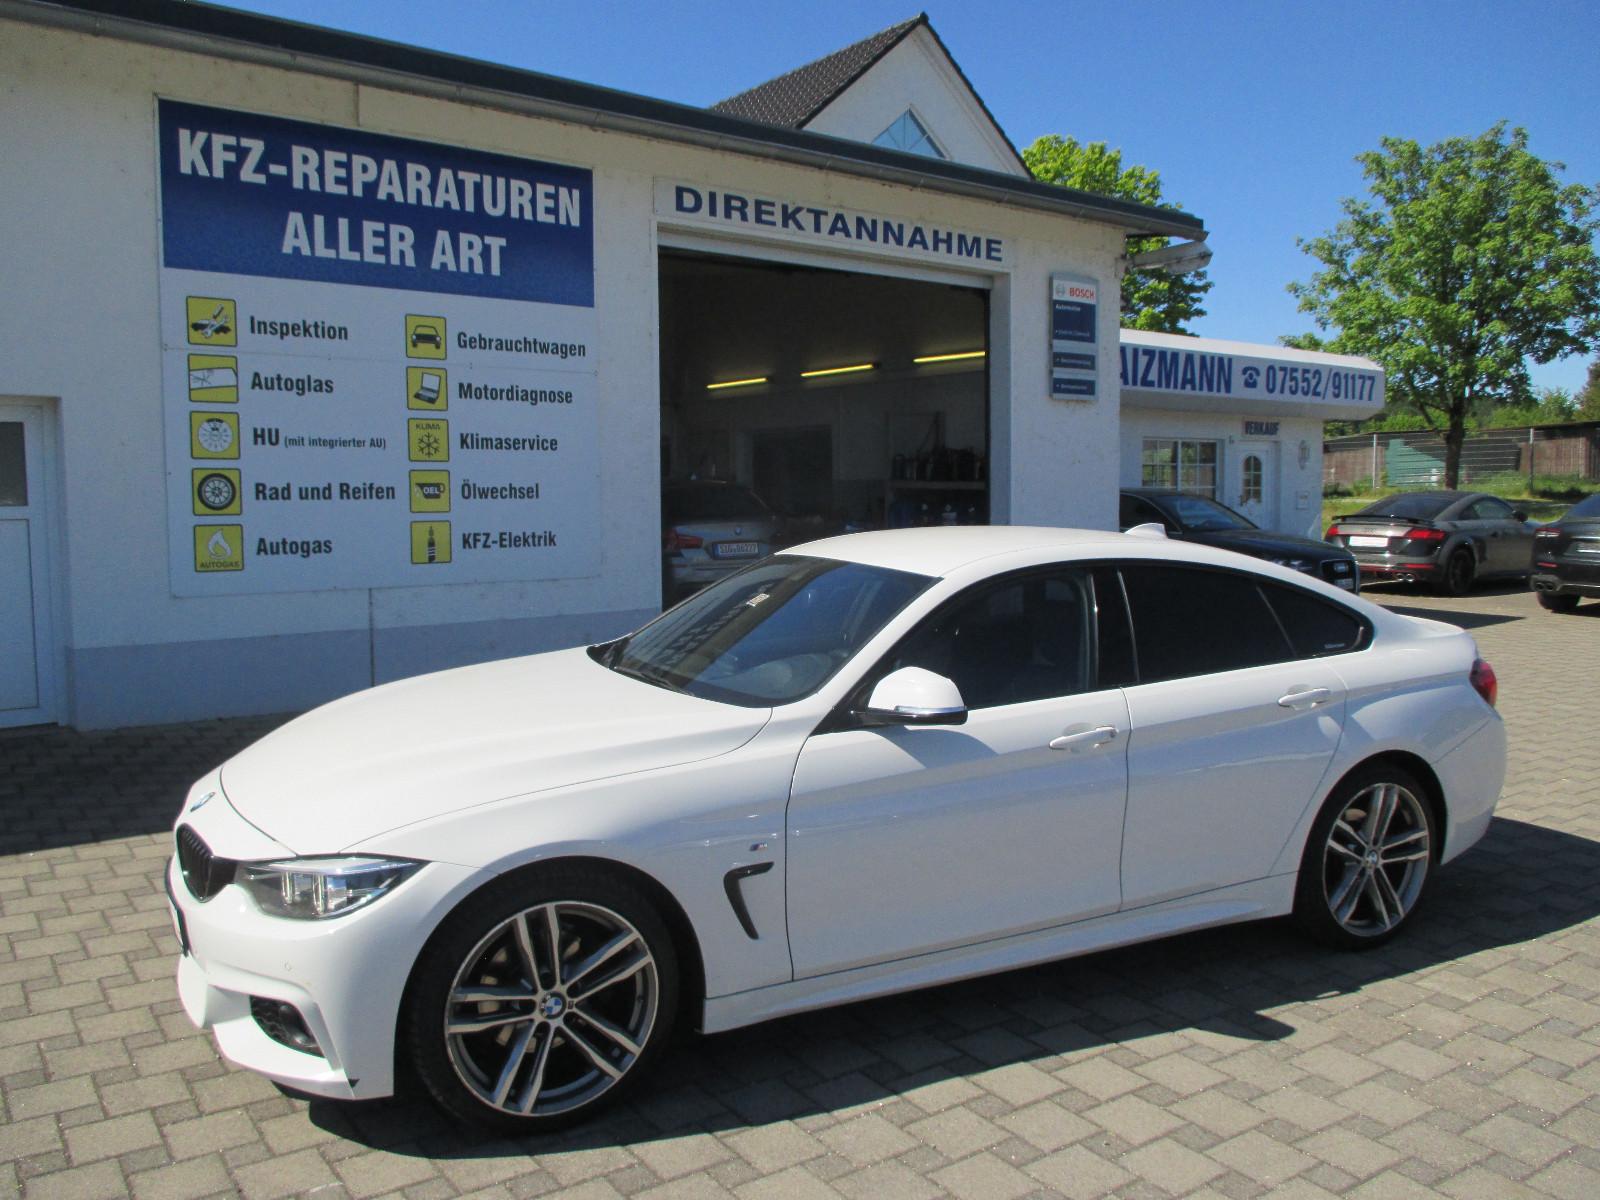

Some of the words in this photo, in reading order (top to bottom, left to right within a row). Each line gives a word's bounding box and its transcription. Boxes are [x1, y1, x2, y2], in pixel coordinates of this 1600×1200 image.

[178, 127, 581, 228] KFZ-REPARATUREN
[675, 185, 1004, 263] DIREKTANNAHME
[281, 211, 417, 268] ALLER
[430, 230, 508, 277] ART
[1069, 287, 1095, 299] BOSCH
[250, 316, 348, 340] Inspektion
[457, 331, 587, 360] Gebrauchtwagen
[251, 371, 334, 396] Autoglas
[458, 382, 573, 405] Motordiagnose
[1265, 365, 1376, 401] 07552/91177
[254, 427, 280, 446] HU
[284, 436, 305, 448] (mit
[308, 437, 366, 449] integrierter
[369, 437, 386, 449] AU)
[459, 433, 558, 451] Klimaservice
[255, 483, 291, 501] Rad
[299, 483, 332, 501] und
[339, 482, 396, 500] Reifen
[461, 479, 540, 500] Ölwechsel
[256, 538, 333, 559] Autogas
[462, 531, 557, 549] KFZ-Elektrik
